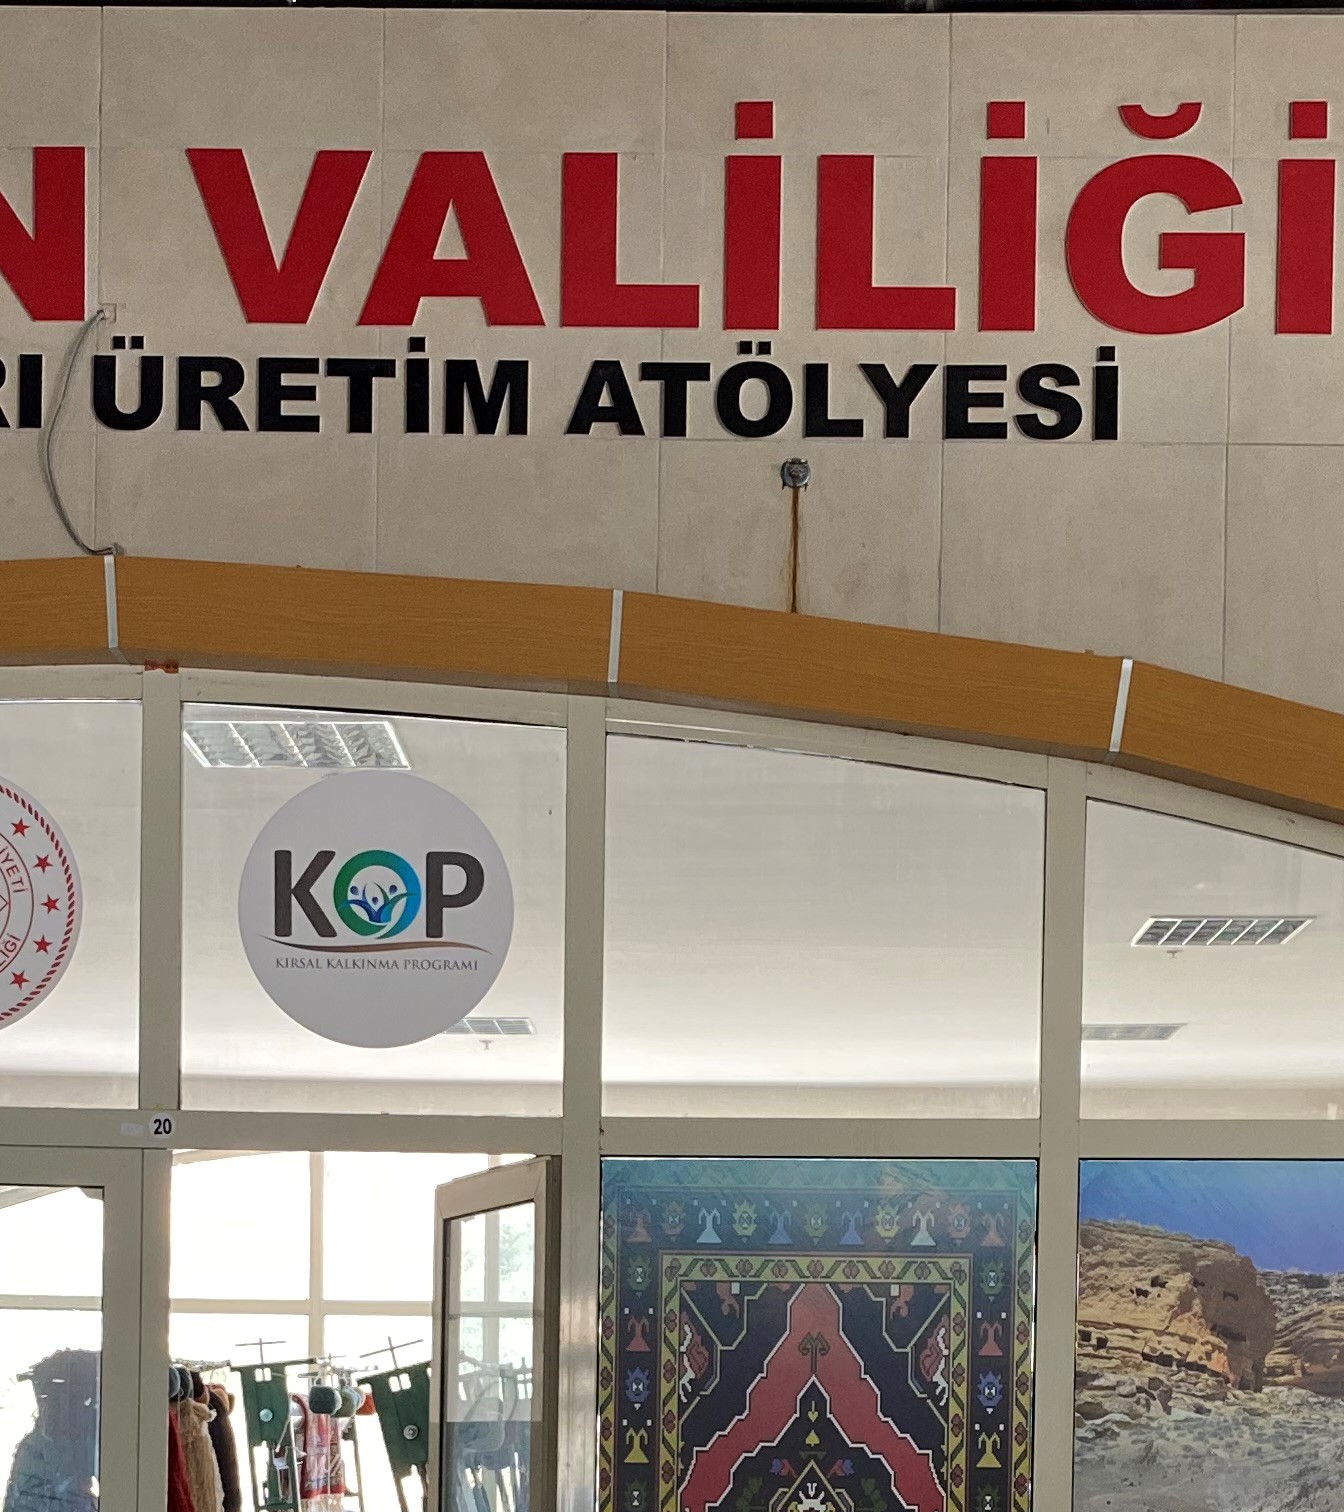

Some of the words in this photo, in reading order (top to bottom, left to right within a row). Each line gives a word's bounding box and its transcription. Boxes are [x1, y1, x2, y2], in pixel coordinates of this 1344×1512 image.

[186, 100, 1335, 335] VALİLİĞİ
[90, 335, 530, 437] ÜRETİM
[564, 341, 1120, 441] ATÖLYESİ
[274, 850, 485, 939] KOP
[275, 957, 323, 971] KIRSAL
[326, 958, 399, 971] KALKINMA
[403, 959, 479, 972] PROGRAMI
[153, 1118, 172, 1135] 20
